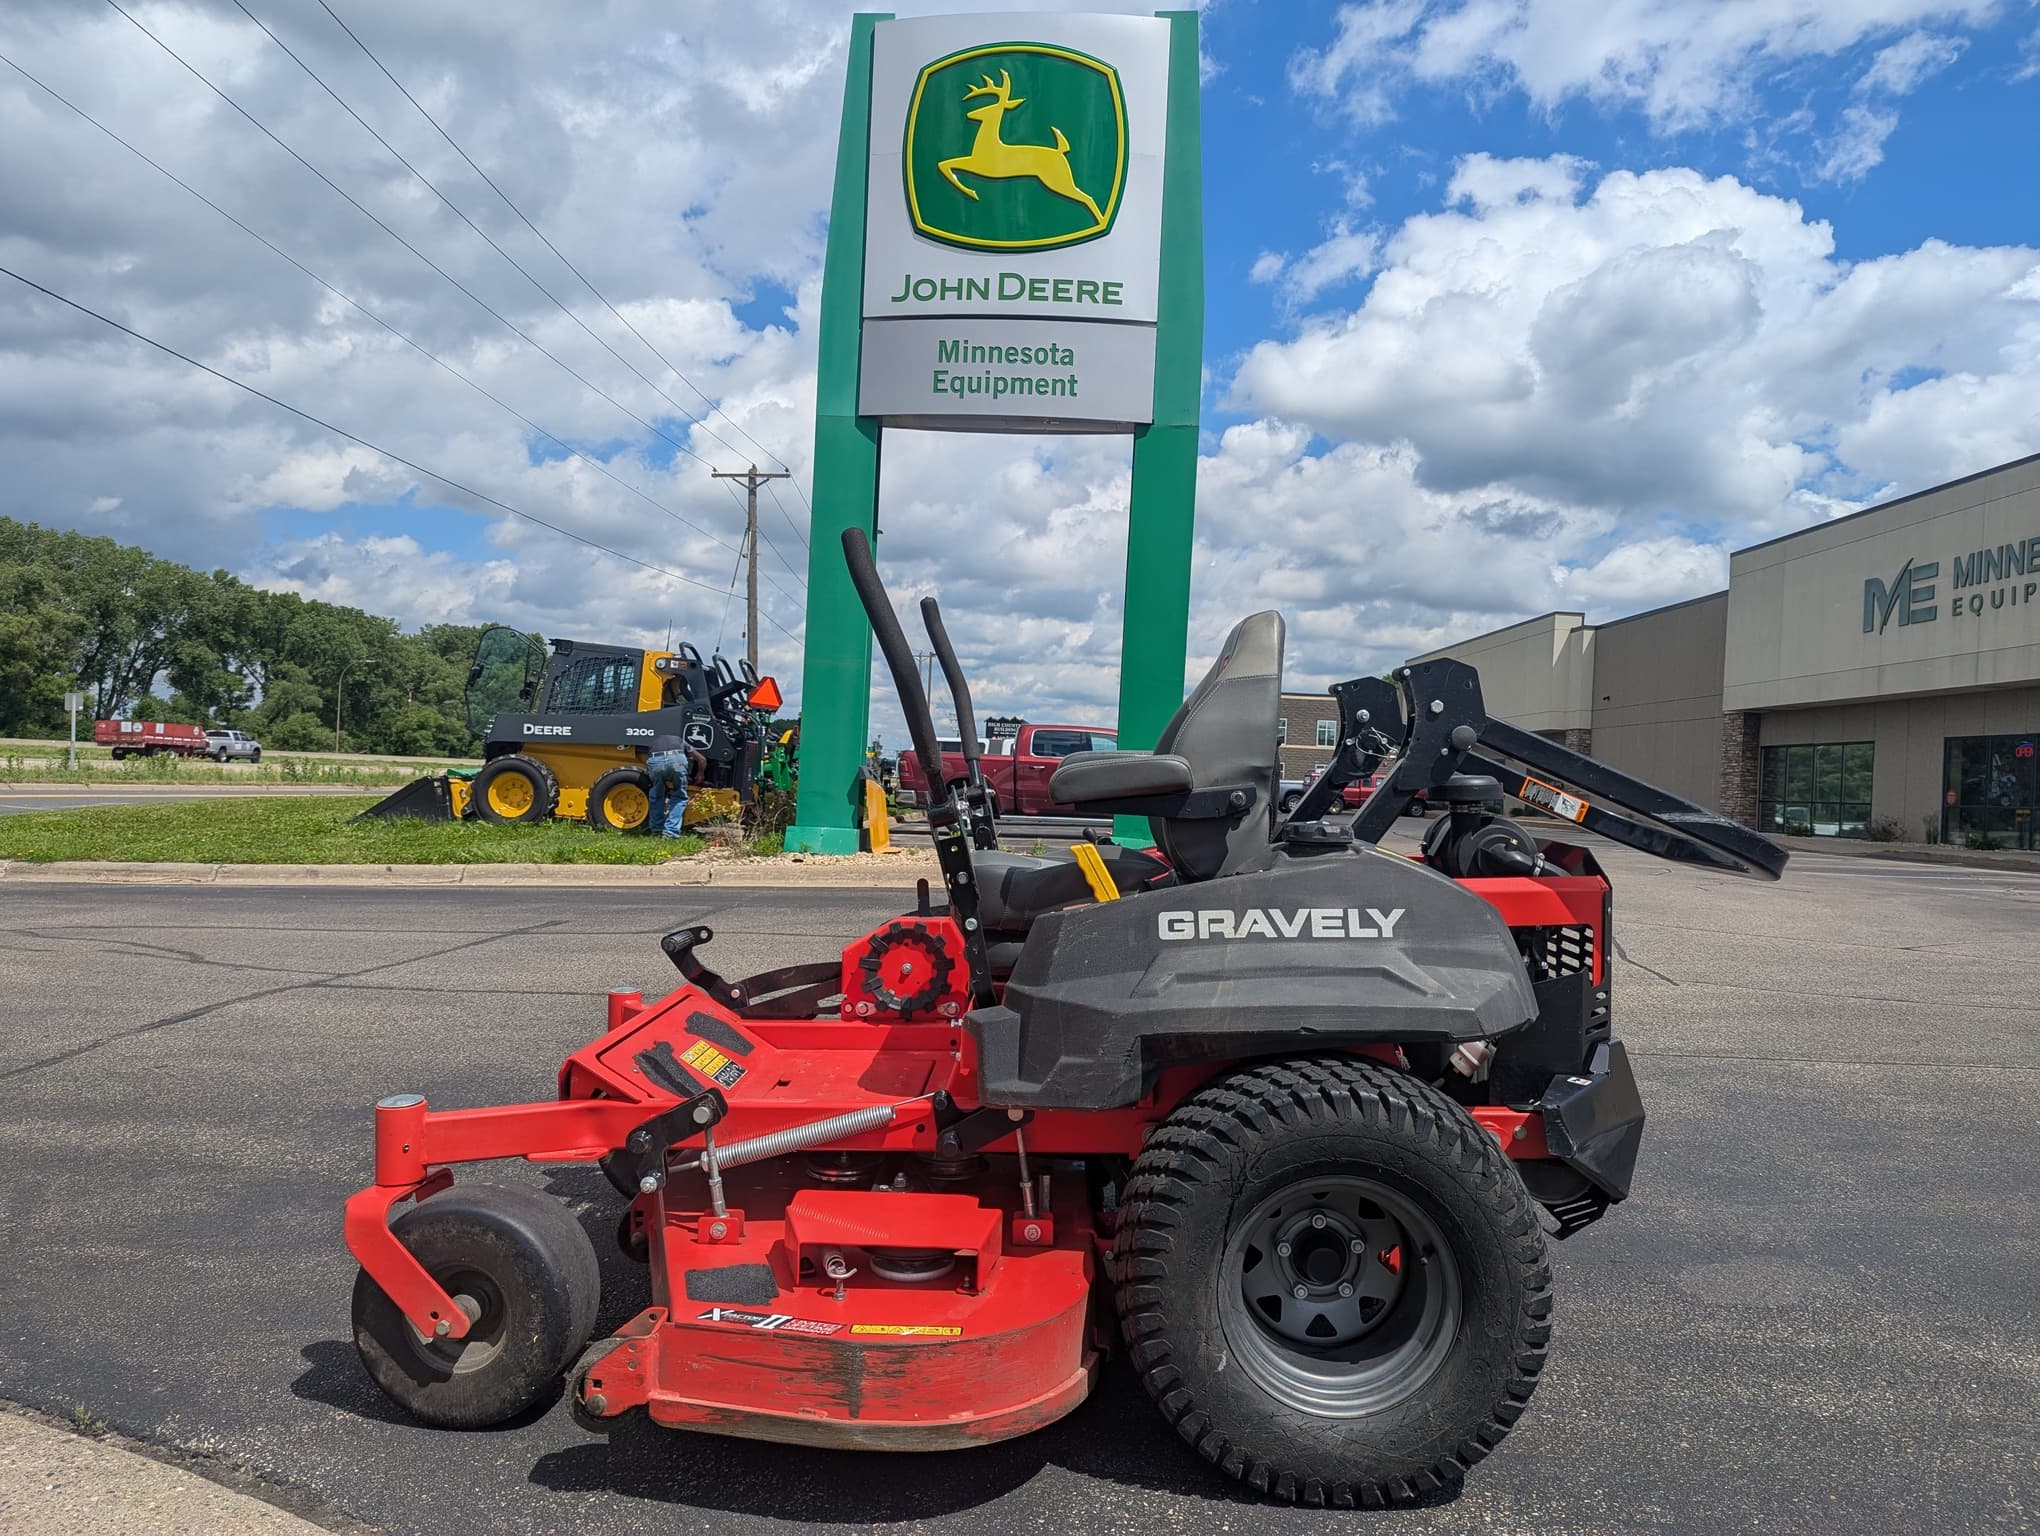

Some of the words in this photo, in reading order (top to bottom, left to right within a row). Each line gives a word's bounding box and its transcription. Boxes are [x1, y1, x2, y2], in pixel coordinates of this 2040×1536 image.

[890, 273, 990, 303] JOHN
[998, 272, 1124, 305] DEERE
[937, 339, 1075, 367] Minnesota
[932, 369, 1078, 399] Equipment
[1951, 582, 2037, 616] EQUIP
[522, 723, 572, 736] DEERE
[625, 727, 655, 737] 320G
[1157, 908, 1407, 941] GRAVELY
